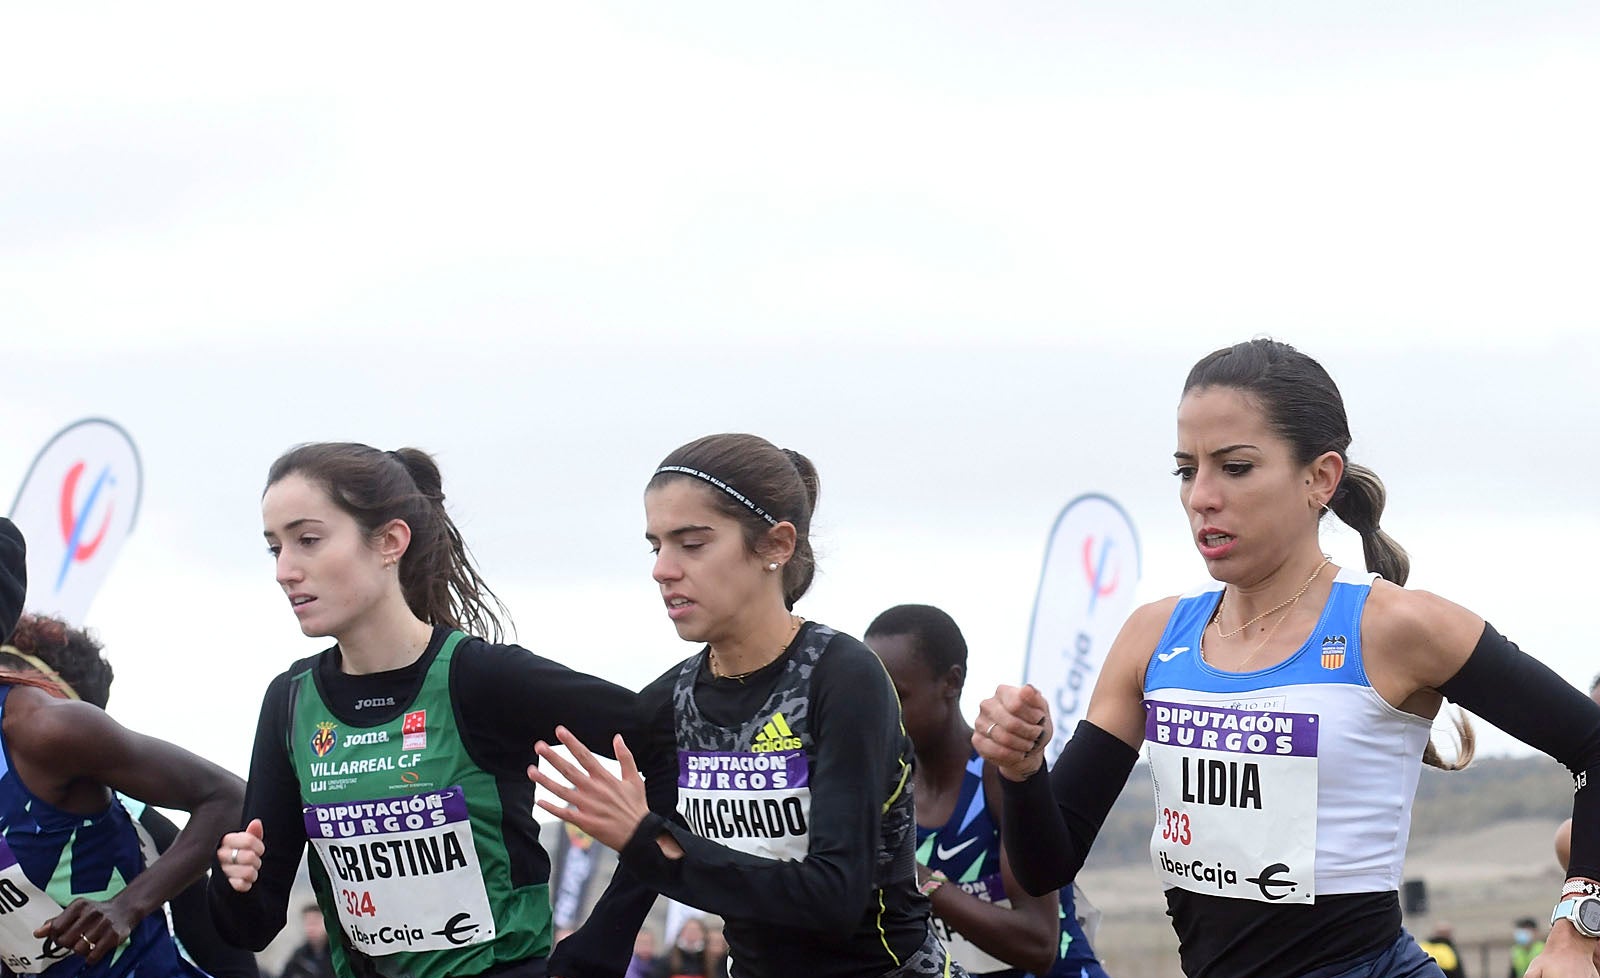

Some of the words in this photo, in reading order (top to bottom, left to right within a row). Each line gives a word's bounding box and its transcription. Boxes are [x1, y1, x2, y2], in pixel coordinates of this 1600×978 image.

[1156, 707, 1293, 734] DIPUTACIÓN
[751, 737, 803, 753] adidas
[1156, 725, 1293, 754] BURGOS
[310, 756, 395, 778] VILLARREAL
[687, 753, 787, 771] DIPUTACIÓN
[687, 771, 788, 789] BURGOS
[1182, 757, 1262, 809] LIDIA
[316, 794, 444, 822] DIPUTACIÓN
[685, 796, 807, 838] MACHADO
[319, 810, 447, 838] BURGOS
[1162, 808, 1192, 845] 333
[328, 831, 467, 882] CRISTINA
[1159, 851, 1237, 889] iberCaja
[342, 889, 376, 917] 324
[350, 924, 424, 946] iberCaja
